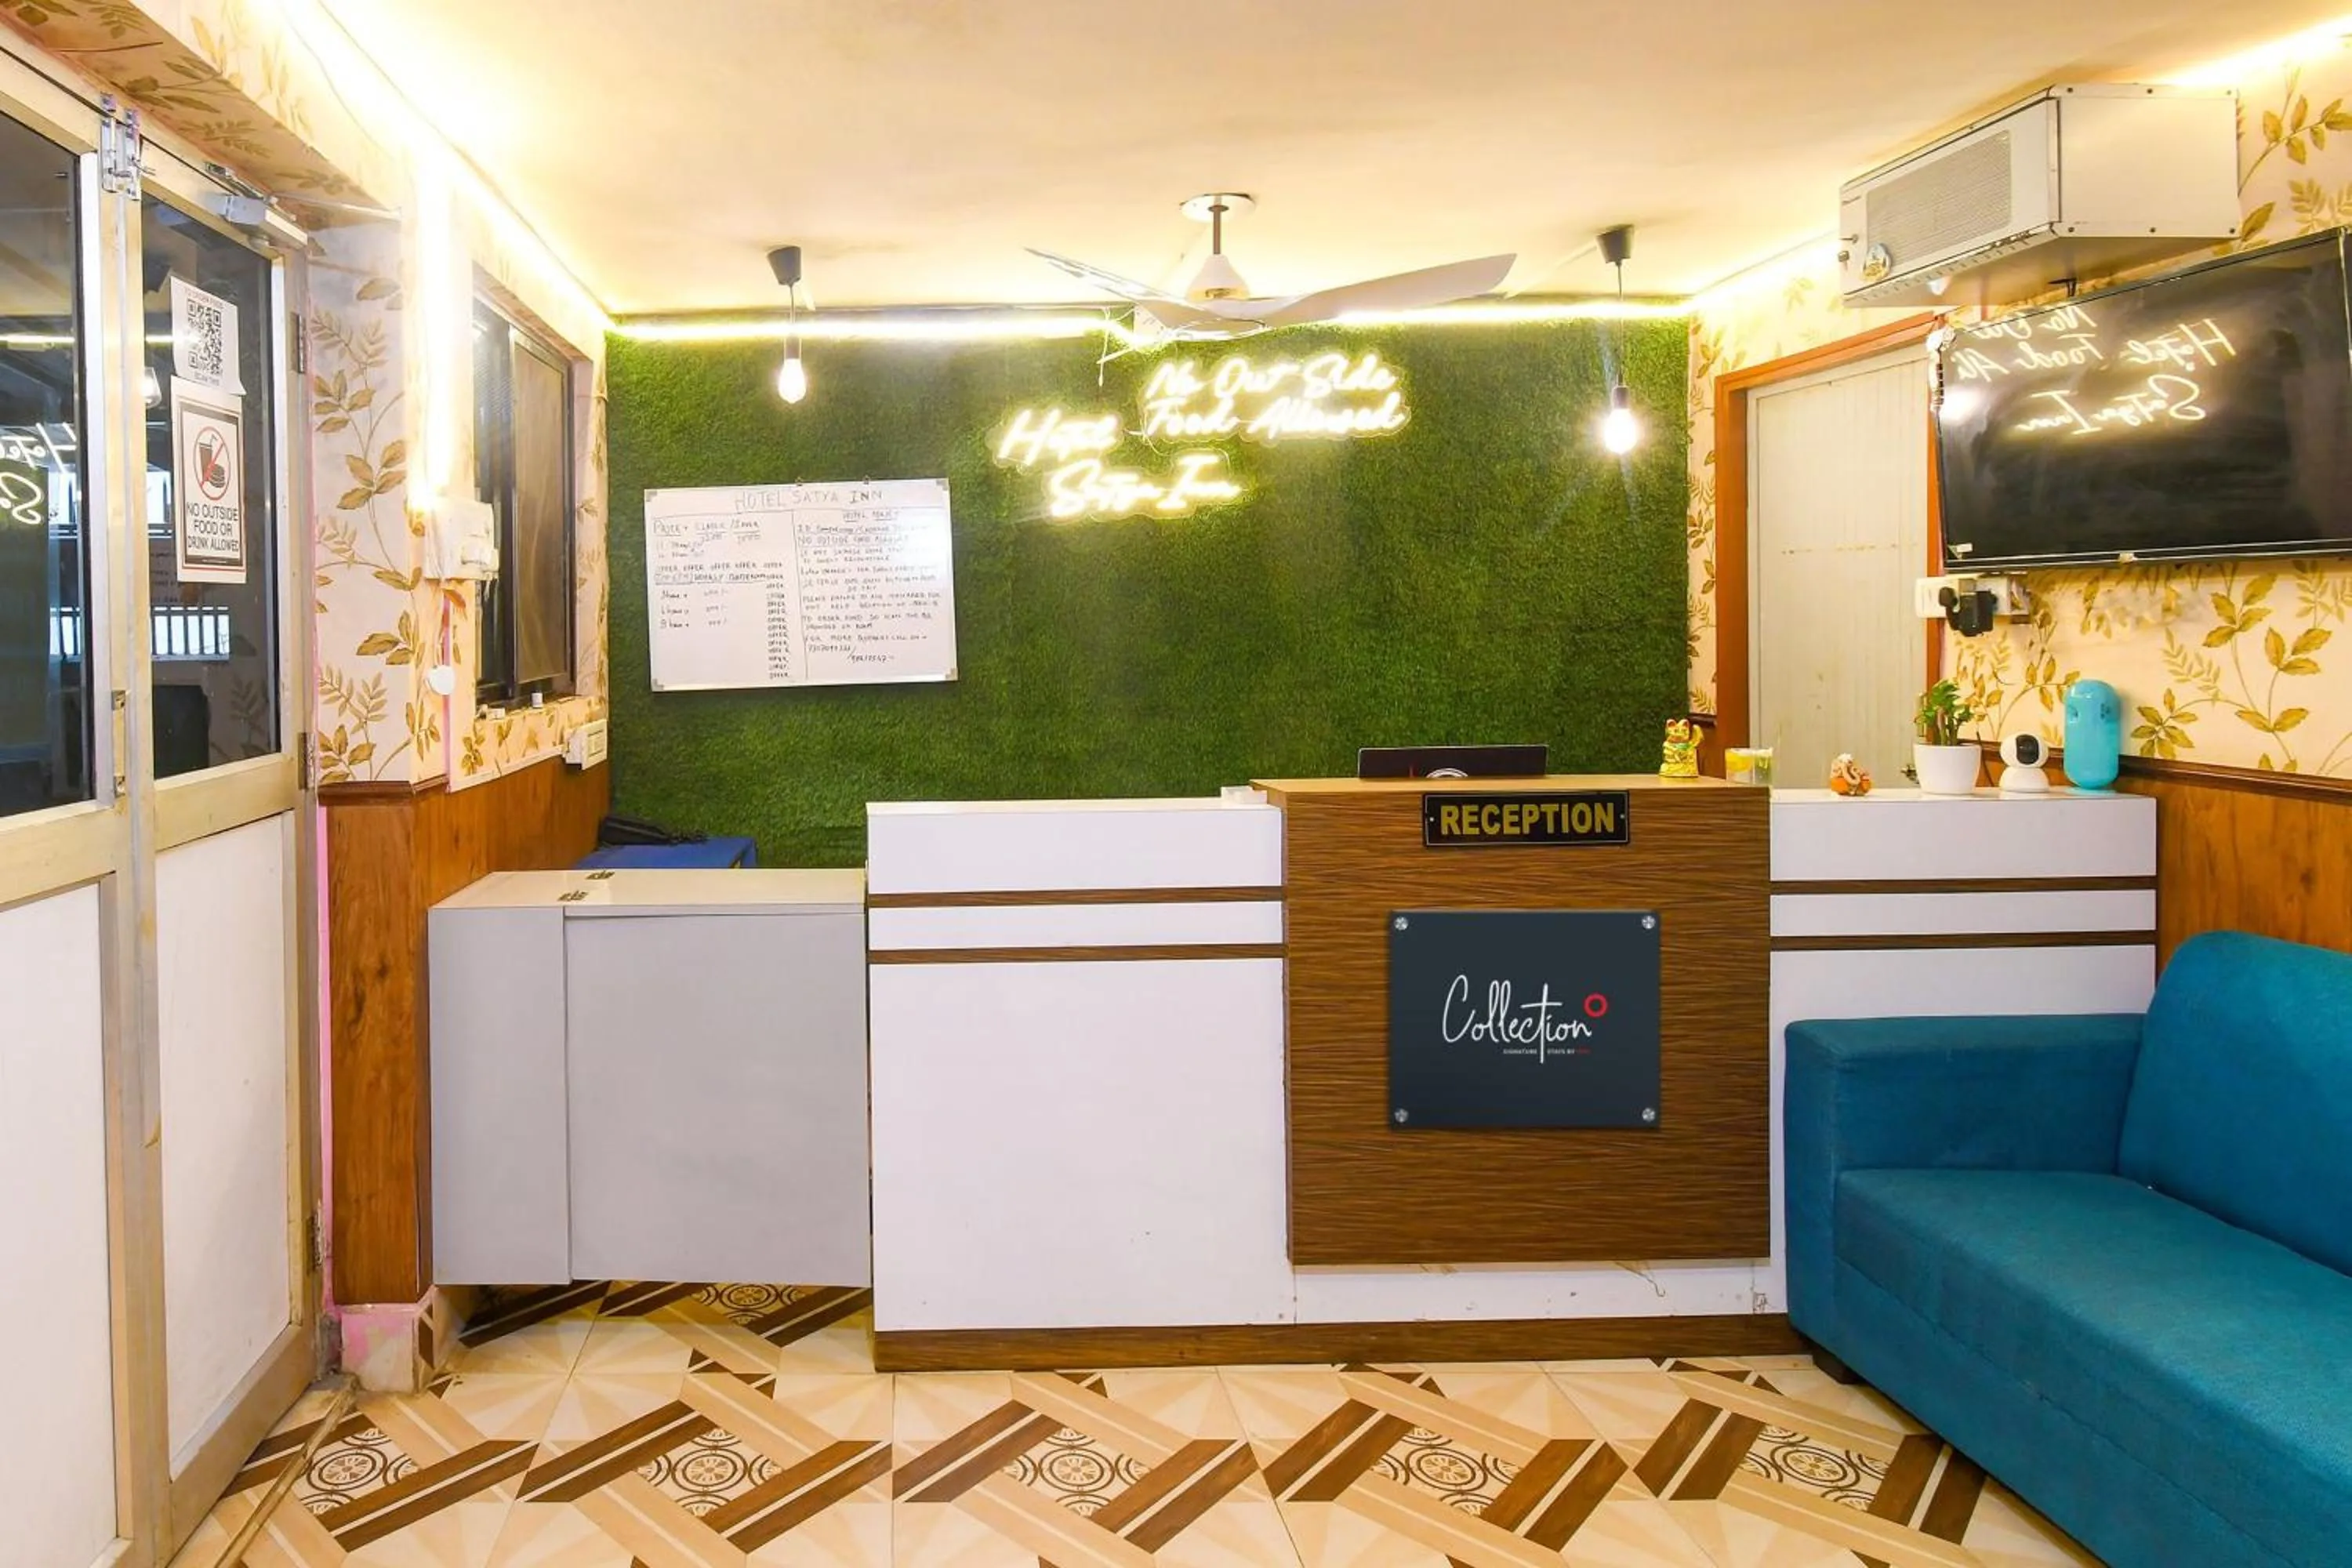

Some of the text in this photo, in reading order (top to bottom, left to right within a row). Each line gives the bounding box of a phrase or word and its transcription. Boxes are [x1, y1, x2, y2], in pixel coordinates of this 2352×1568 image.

[1146, 391, 1405, 439] Food Allowed
[187, 503, 239, 522] NO OUTSIDE
[735, 490, 883, 514] HOTEL SATYA INN
[194, 519, 233, 537] FOOD OR
[187, 535, 239, 552] DRINK ALLOWED
[1440, 802, 1614, 835] RECEPTION
[1442, 975, 1592, 1064] Collection
